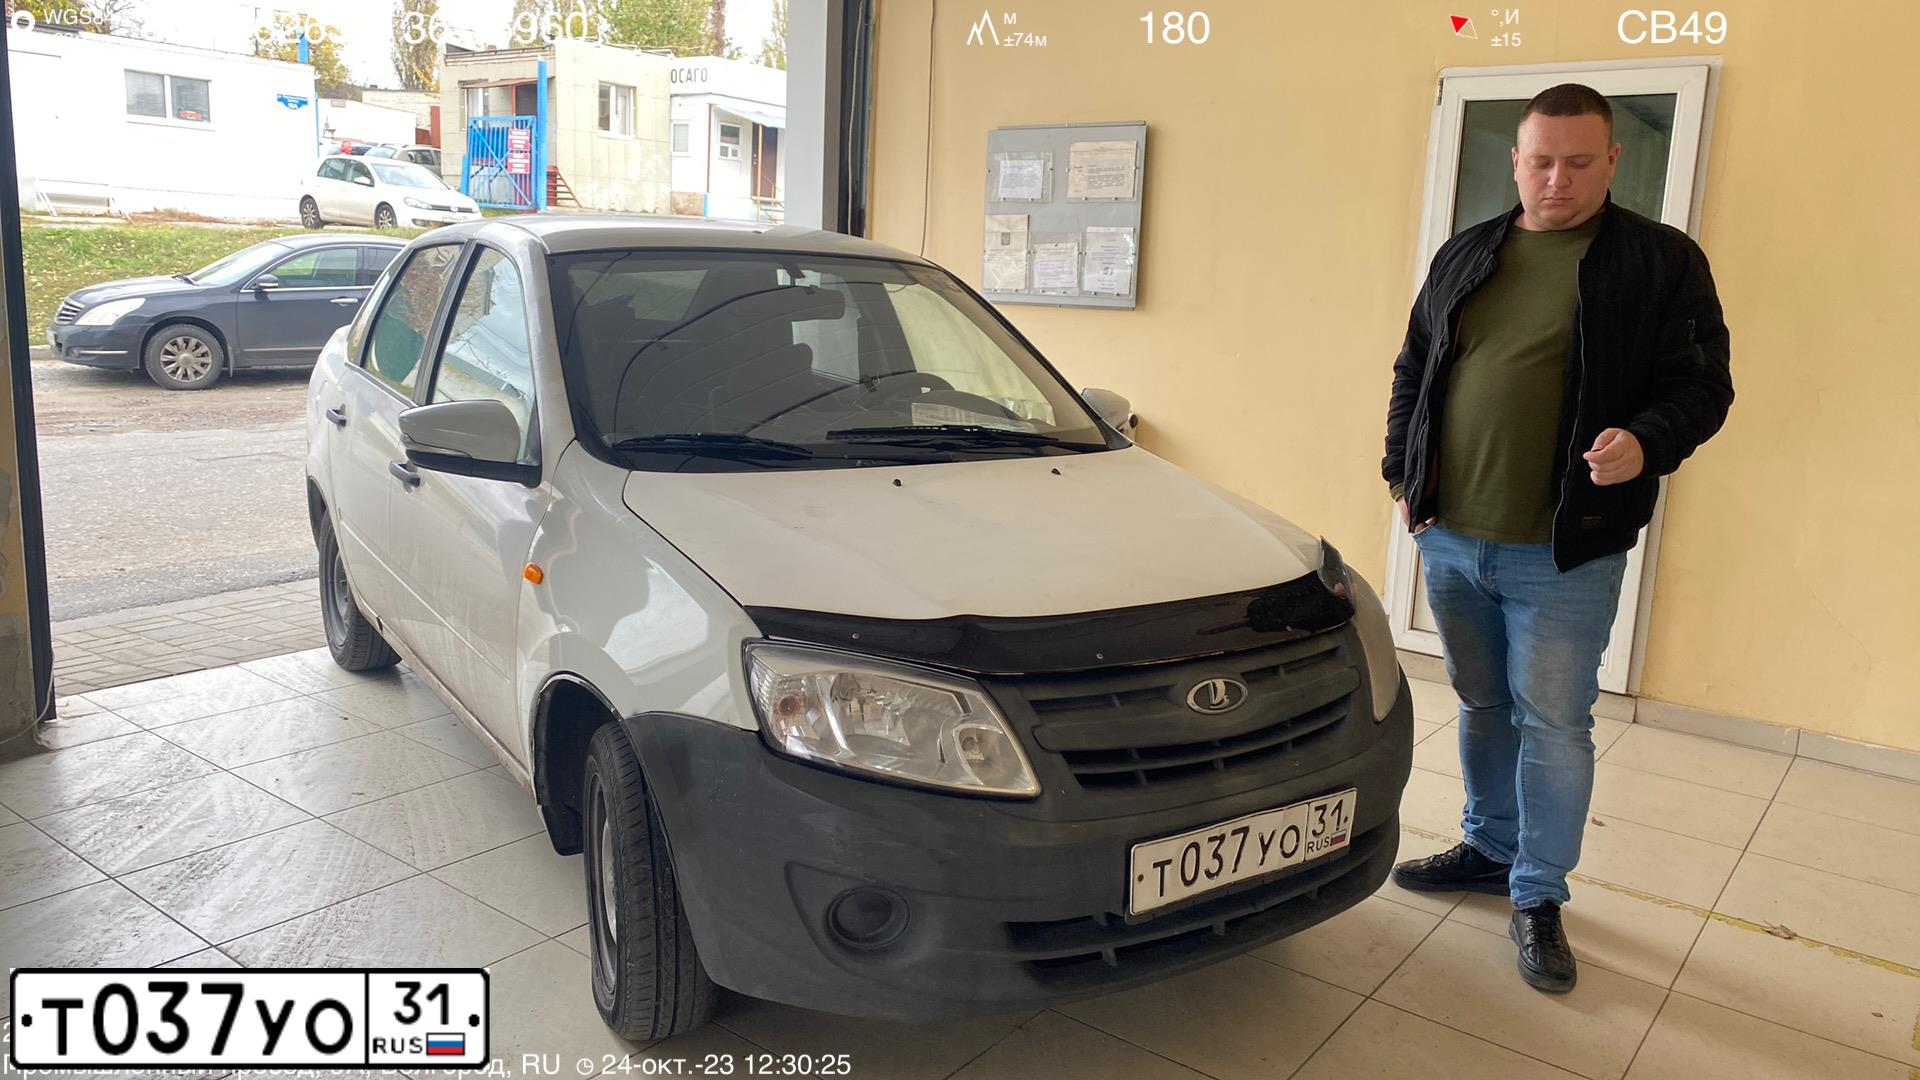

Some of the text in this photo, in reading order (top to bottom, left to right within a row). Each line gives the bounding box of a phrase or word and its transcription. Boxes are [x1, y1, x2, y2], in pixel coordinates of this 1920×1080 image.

[670, 67, 708, 84] ОСАГО
[1311, 799, 1344, 838] 31
[1307, 838, 1330, 854] RUS
